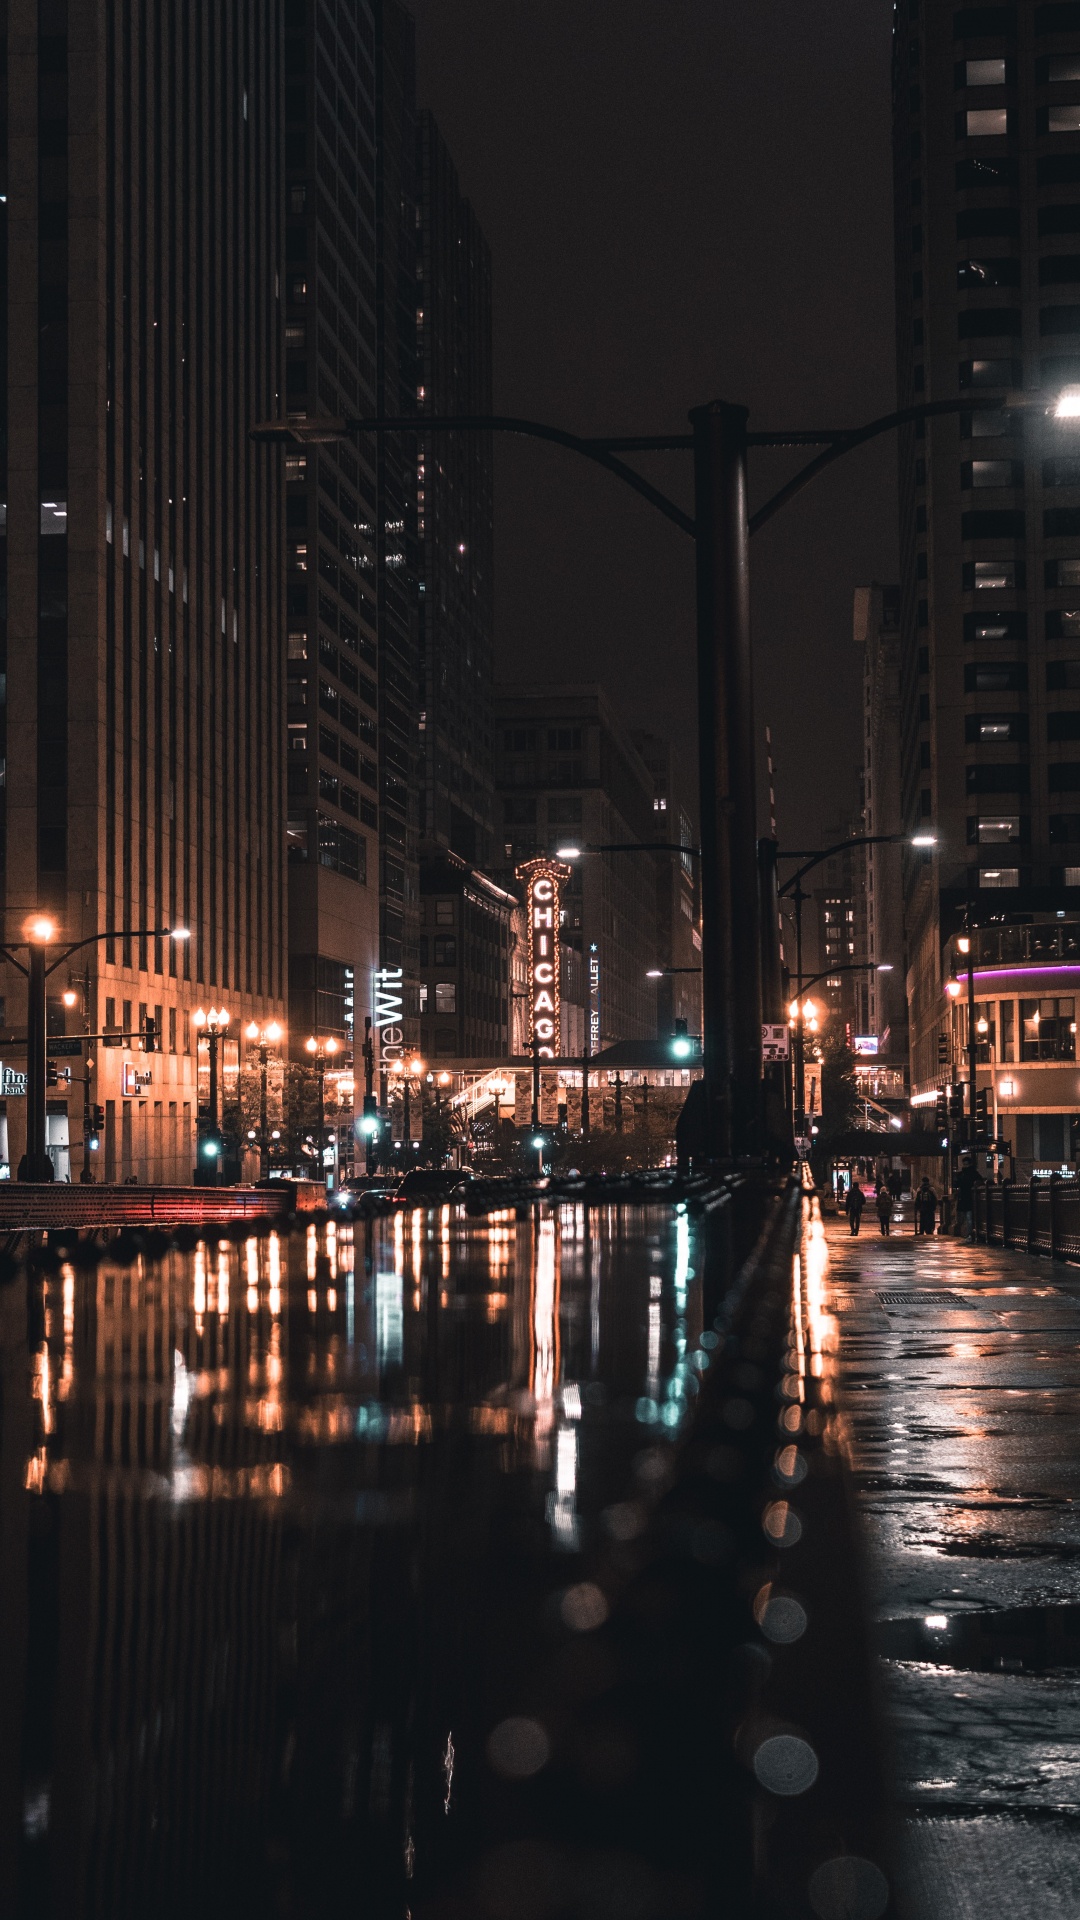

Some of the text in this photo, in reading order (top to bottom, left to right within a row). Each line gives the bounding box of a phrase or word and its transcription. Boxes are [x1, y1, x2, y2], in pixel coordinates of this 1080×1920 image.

[374, 968, 403, 1074] theWit
[590, 958, 599, 1058] OFFREY ALLET
[48, 1043, 74, 1051] WACKER
[2, 1083, 26, 1095] bank
